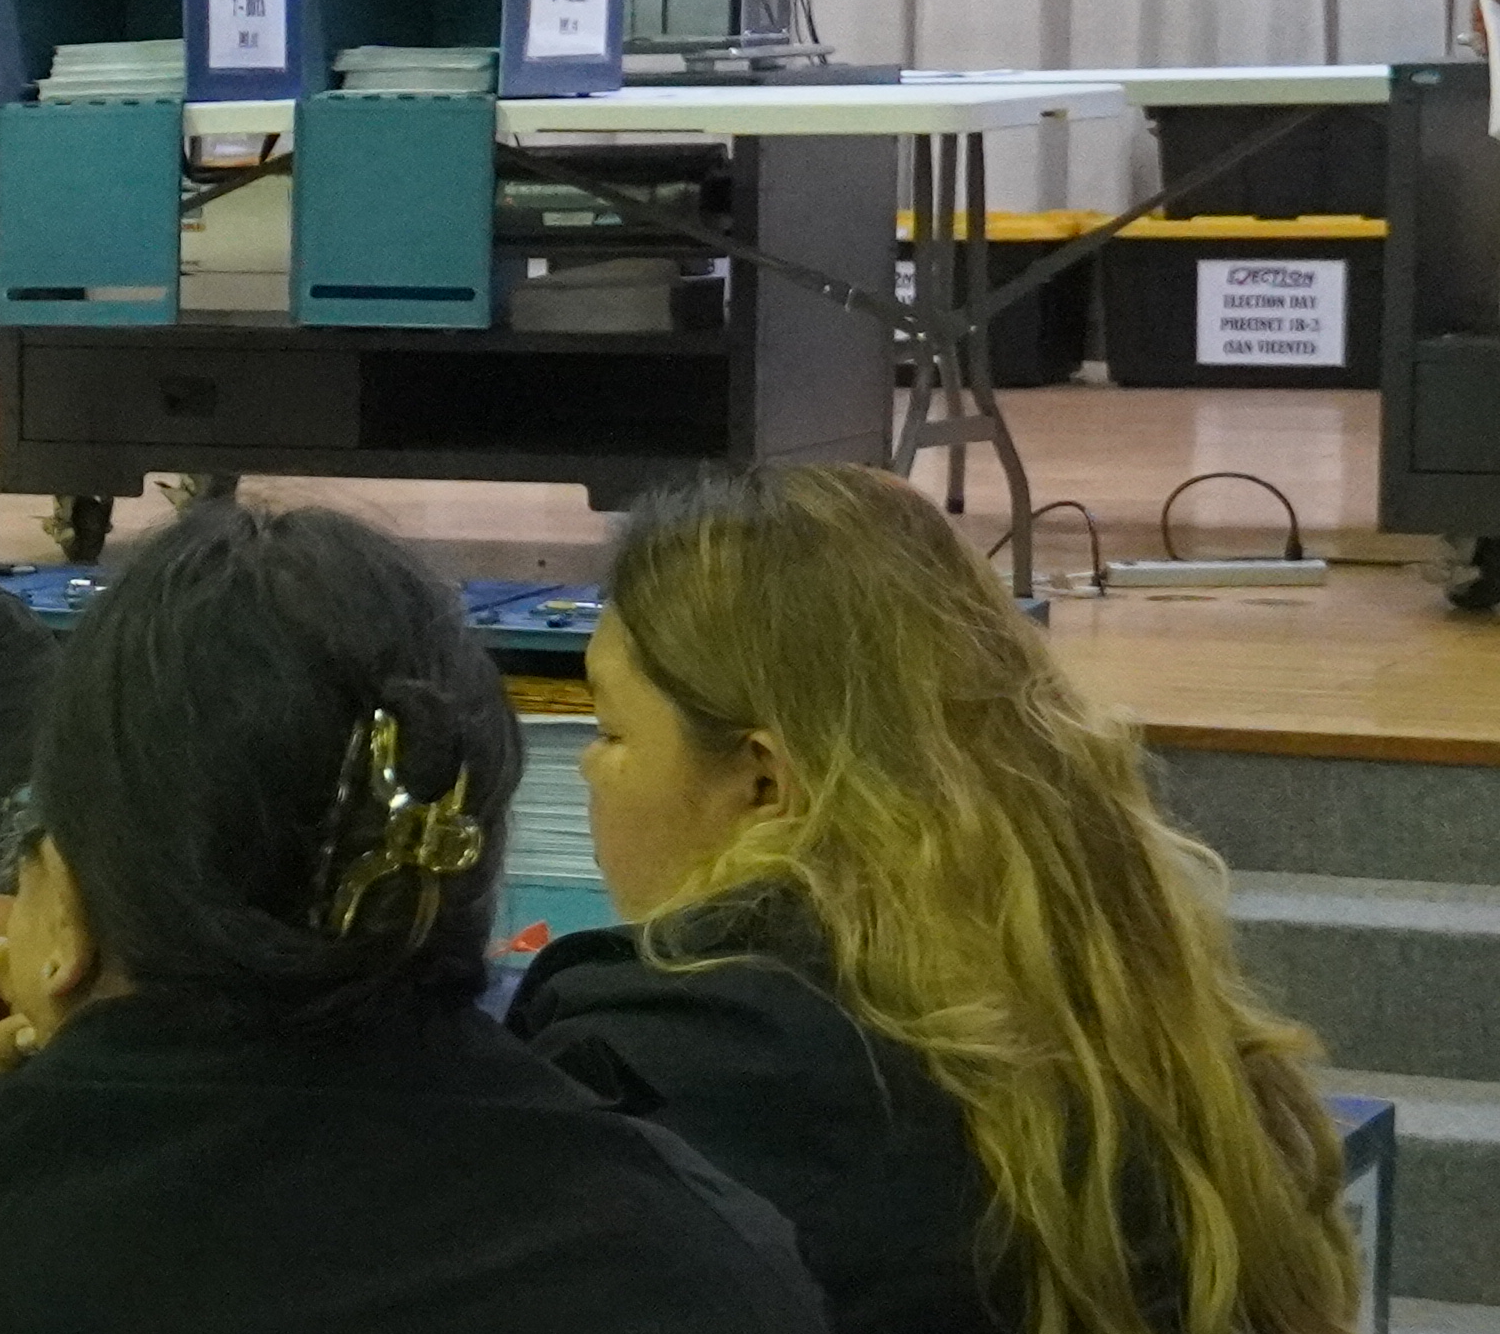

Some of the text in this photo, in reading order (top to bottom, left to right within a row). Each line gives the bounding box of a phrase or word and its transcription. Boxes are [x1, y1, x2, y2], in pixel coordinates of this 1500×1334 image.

[1223, 294, 1317, 309] ELECTION DAY
[1220, 317, 1284, 331] PRECINCT
